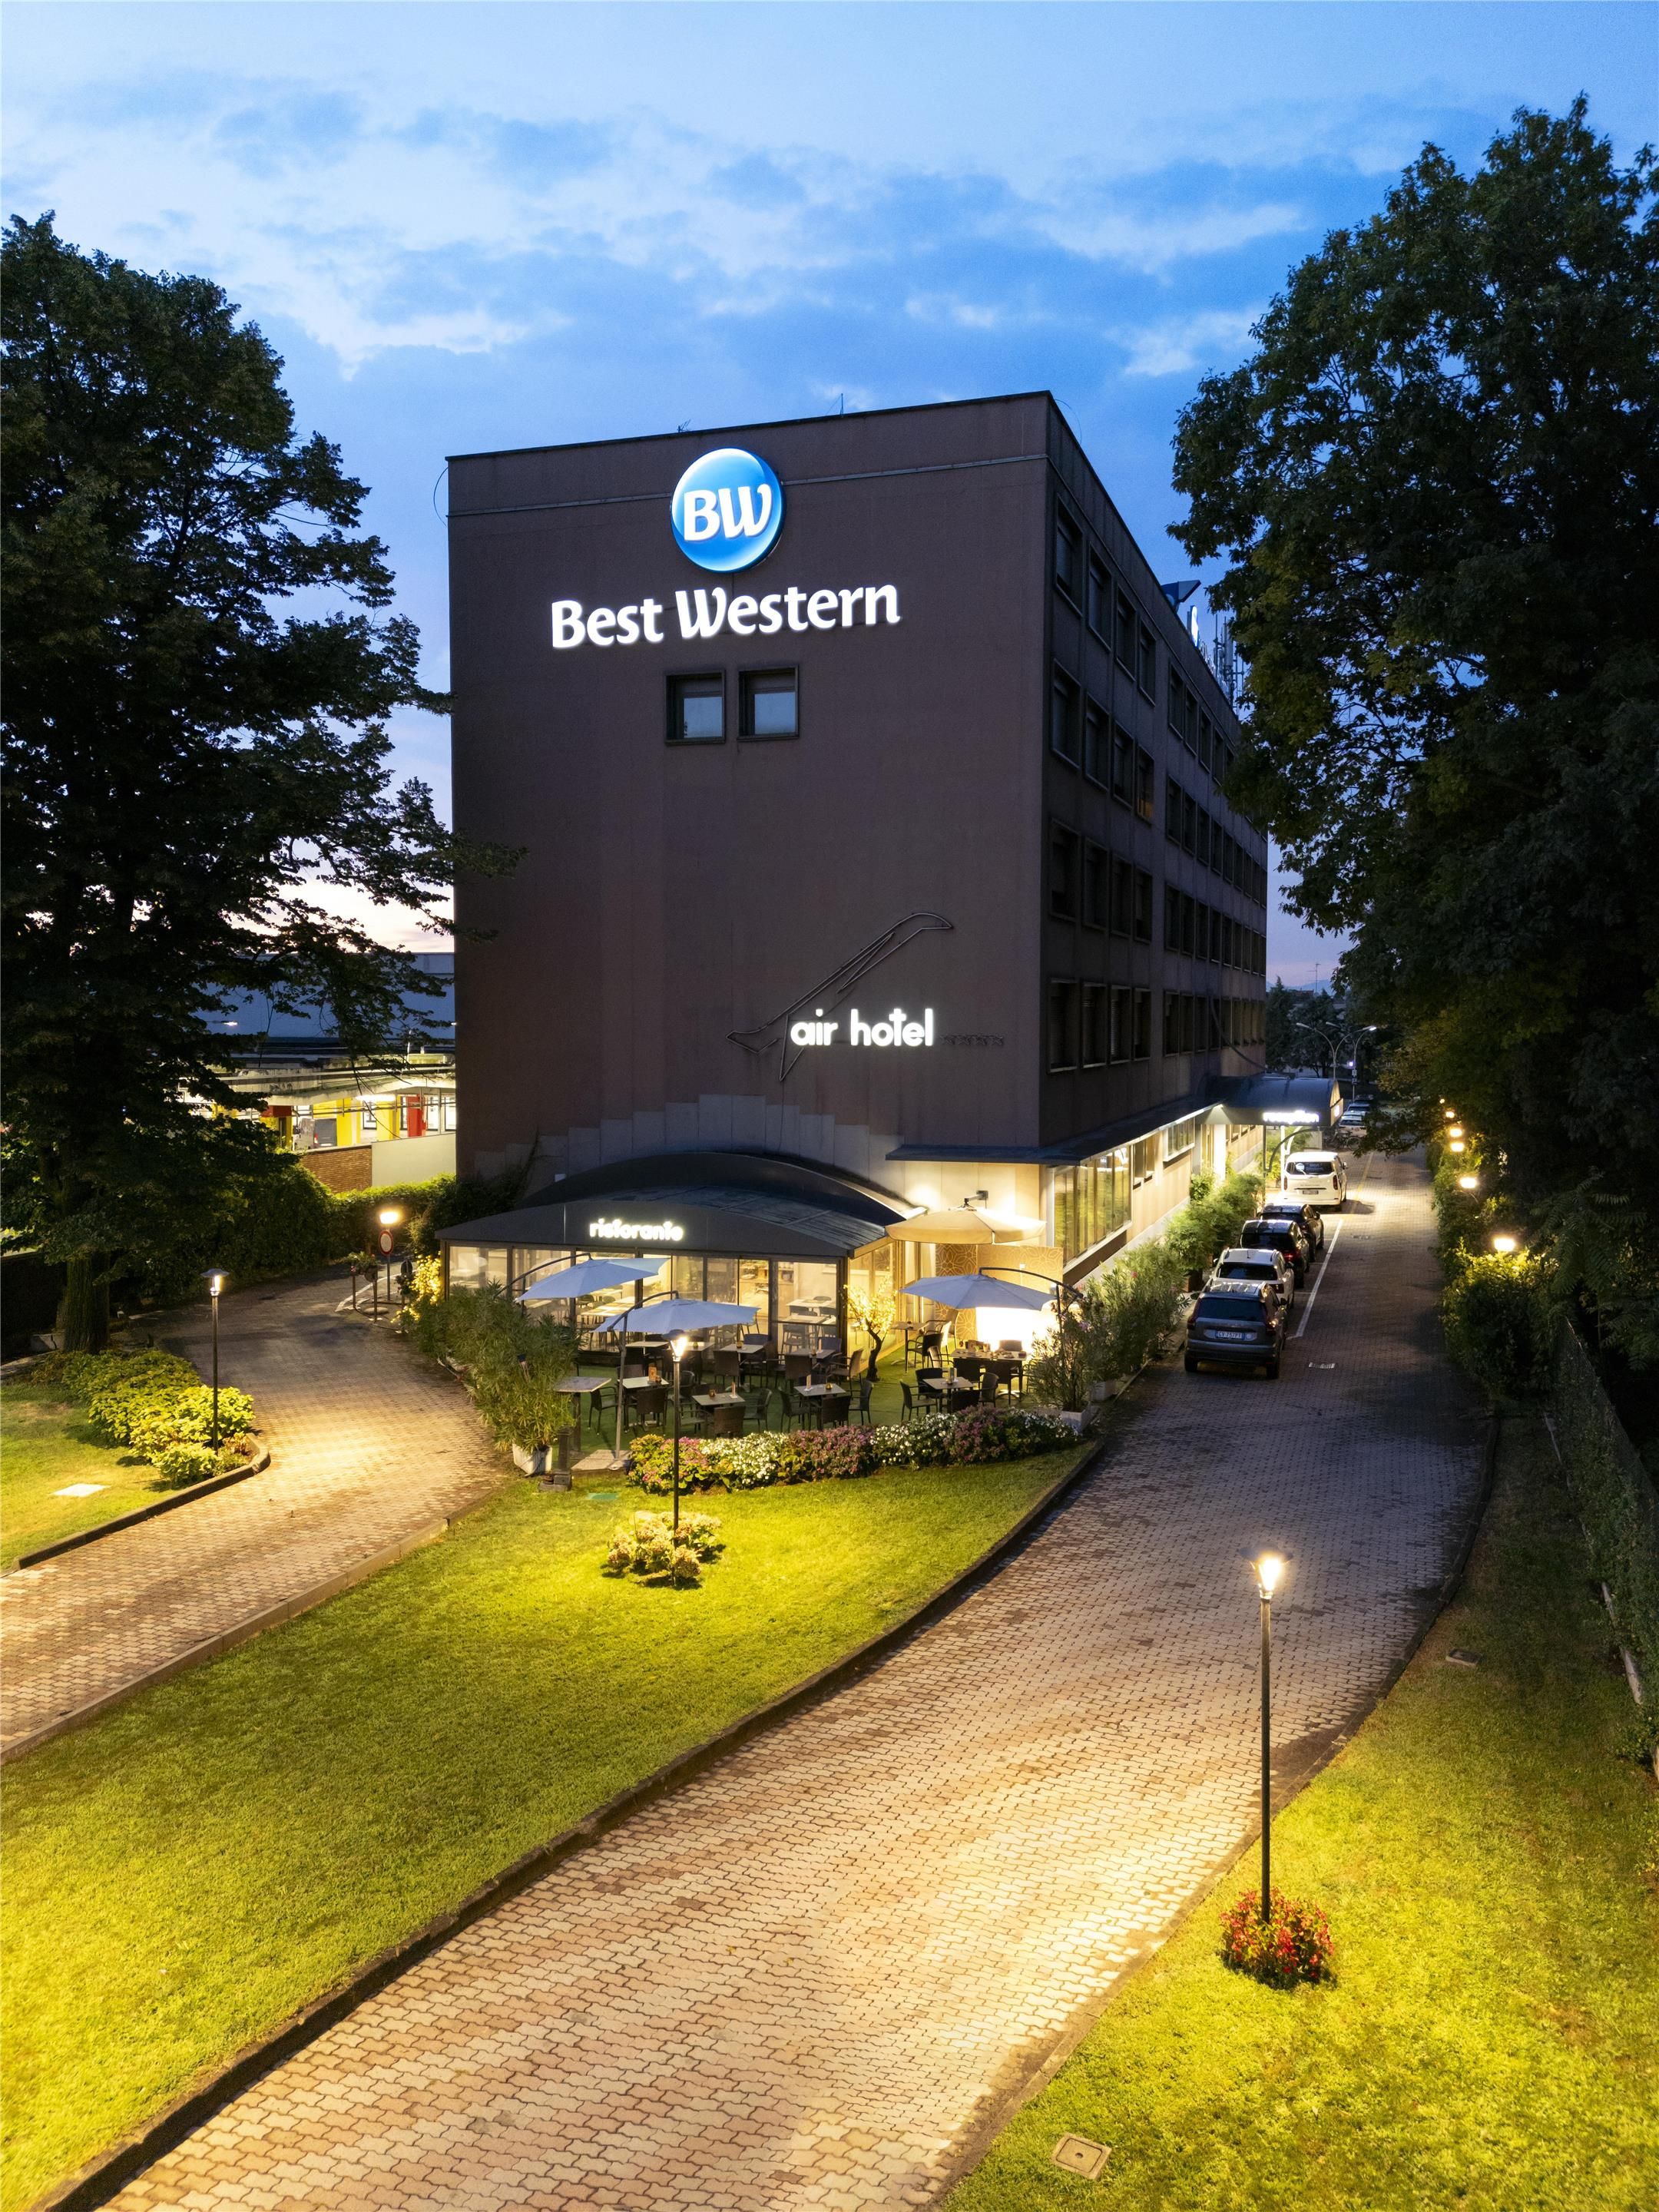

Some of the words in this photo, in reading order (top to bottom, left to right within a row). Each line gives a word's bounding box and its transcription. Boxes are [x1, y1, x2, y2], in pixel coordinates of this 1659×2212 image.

[684, 483, 773, 541] BW
[551, 598, 664, 648] Best
[675, 584, 901, 638] Western
[790, 1008, 838, 1046] air
[850, 1008, 934, 1047] hotel
